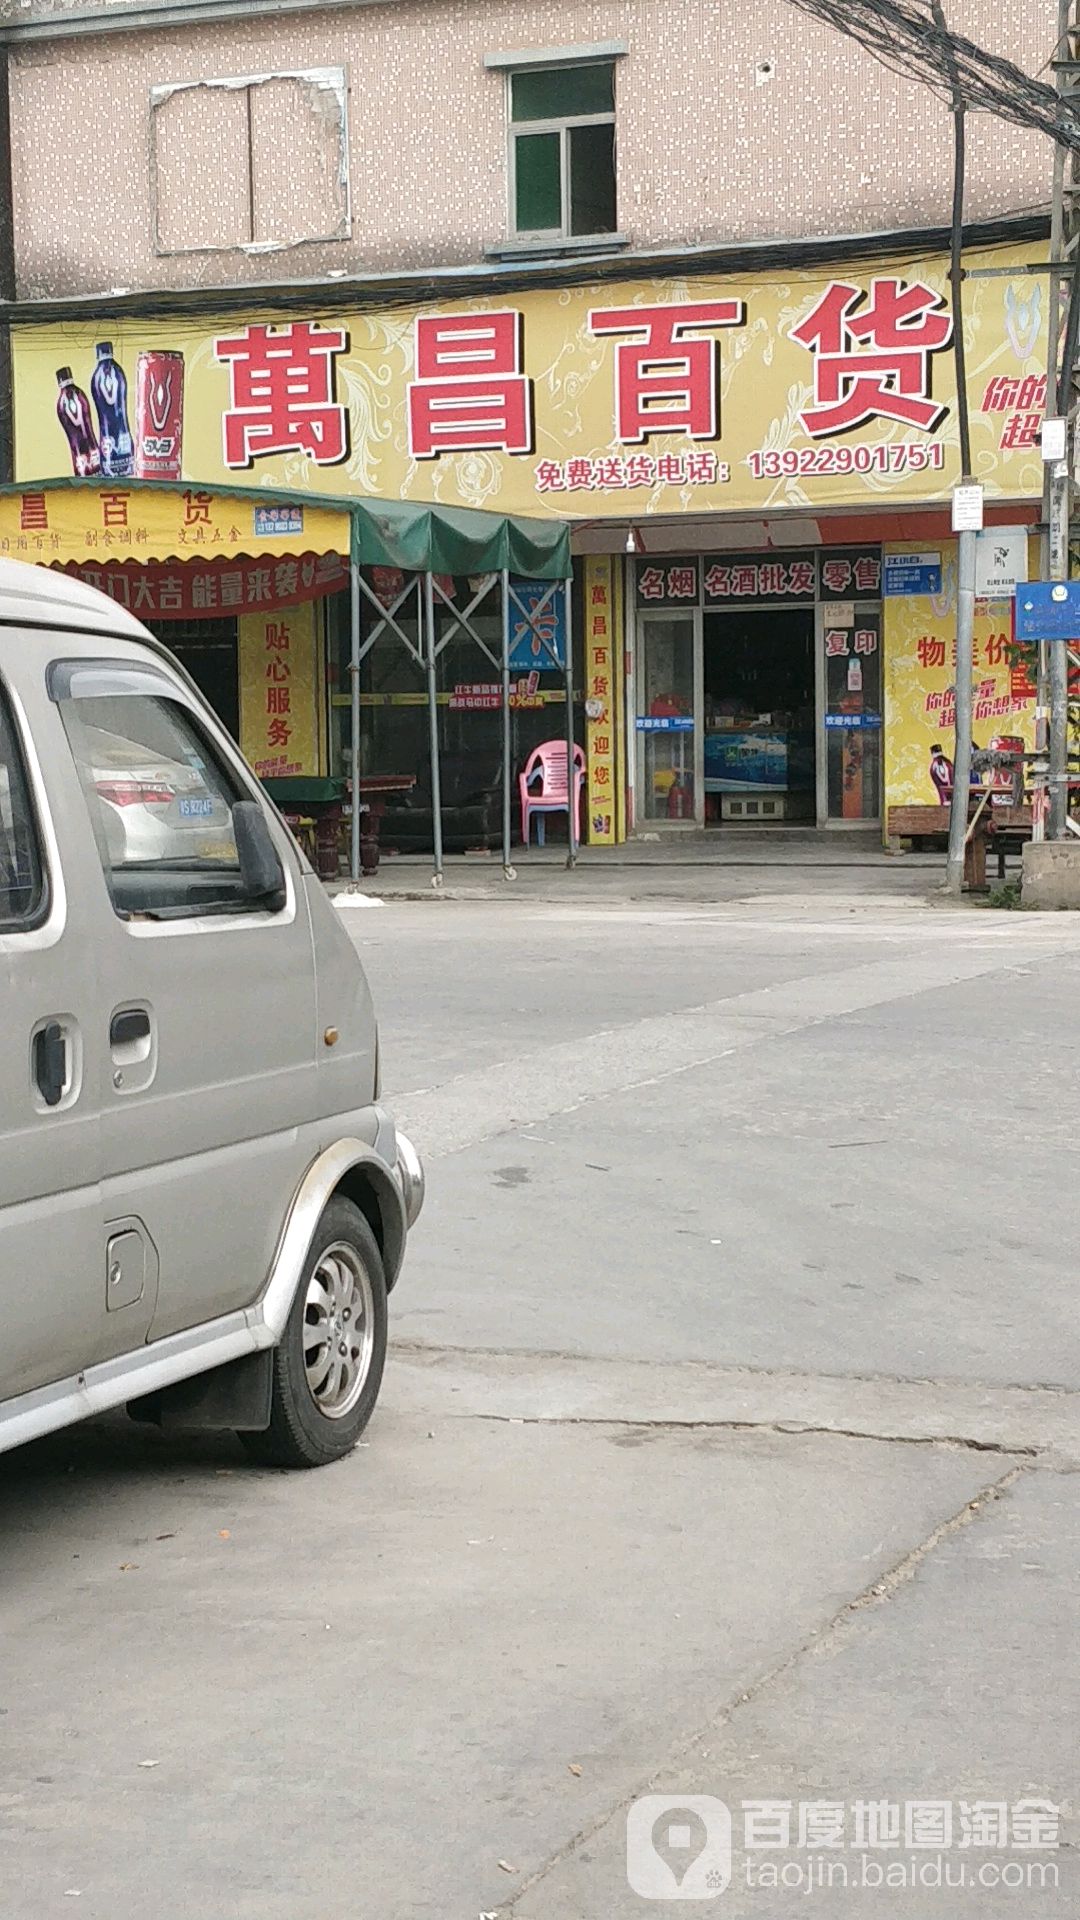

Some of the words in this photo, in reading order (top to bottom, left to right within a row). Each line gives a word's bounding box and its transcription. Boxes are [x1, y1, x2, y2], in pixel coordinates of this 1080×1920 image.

[214, 279, 954, 466] 萬昌百货
[749, 442, 944, 478] 13922901751
[178, 525, 241, 545] 文具五金
[191, 561, 300, 608] 能量来袭
[639, 567, 696, 599] 名烟
[704, 561, 815, 597] 名酒批发
[822, 557, 880, 593] 零售
[826, 629, 876, 656] 复印
[265, 622, 292, 747] 贴心服务
